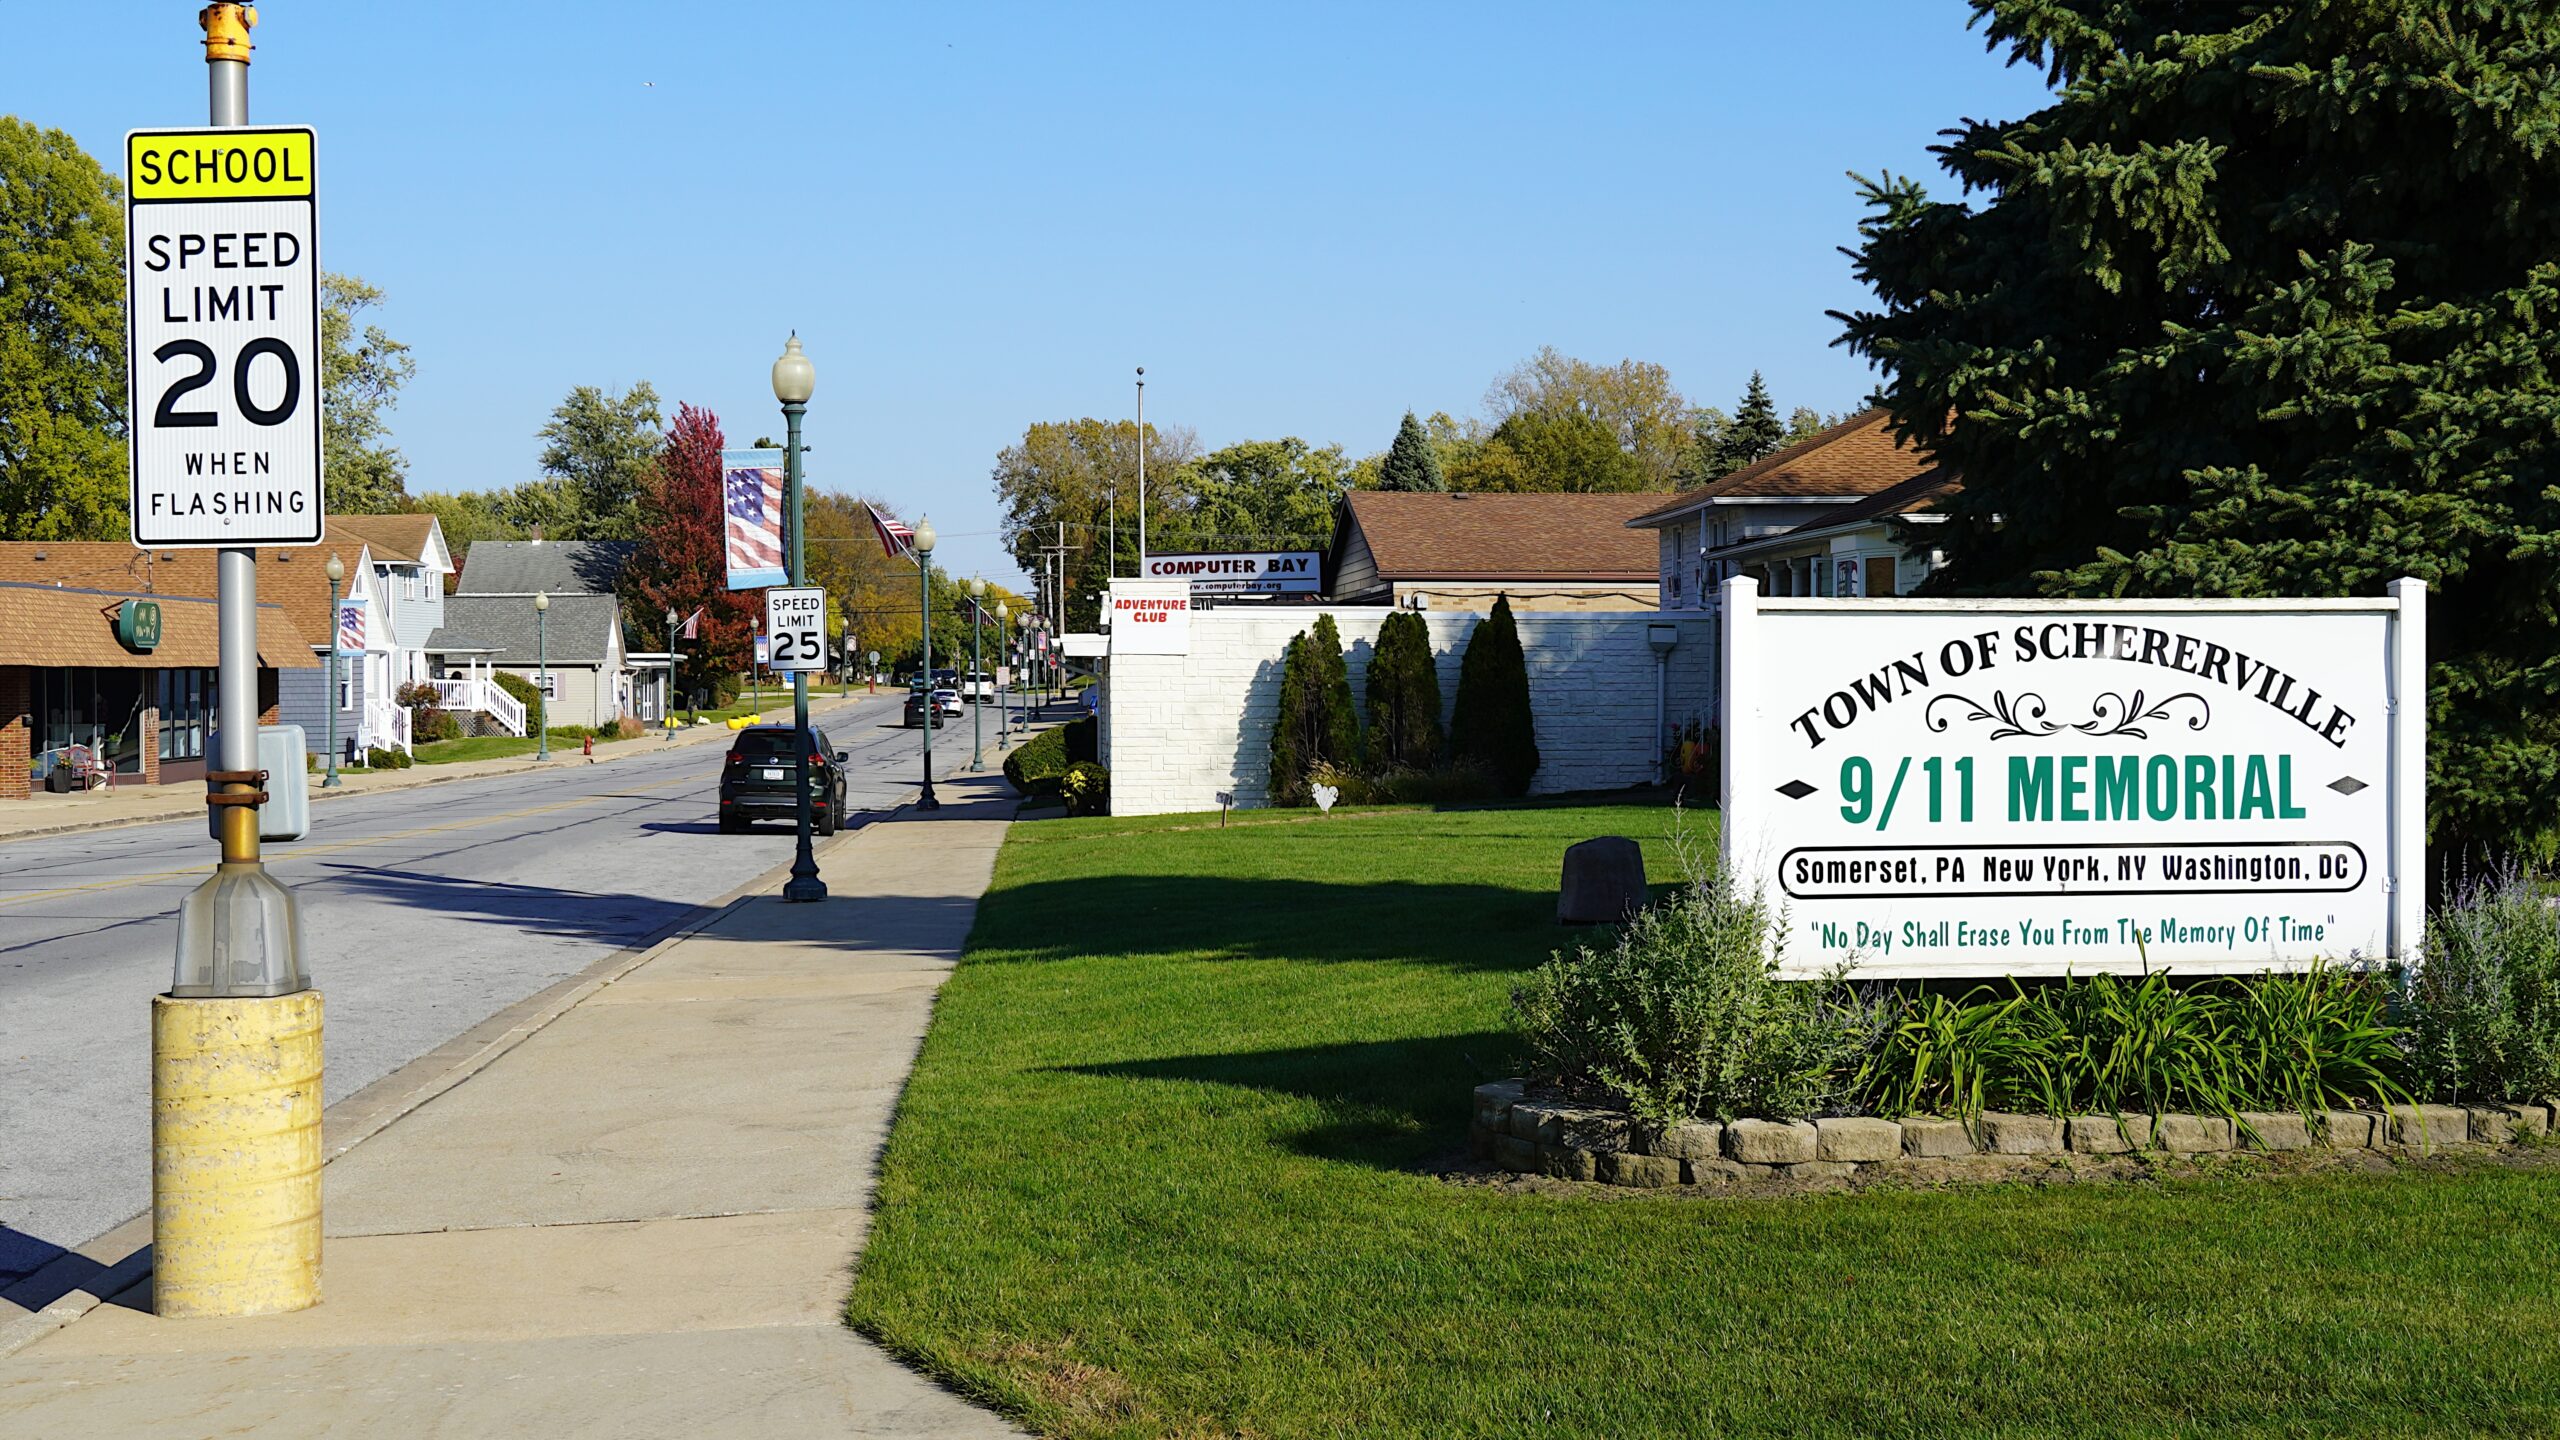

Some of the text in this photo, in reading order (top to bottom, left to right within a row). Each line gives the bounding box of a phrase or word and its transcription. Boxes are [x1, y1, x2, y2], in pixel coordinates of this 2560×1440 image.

[141, 148, 303, 184] SCHOOL
[145, 232, 299, 271] SPEED
[164, 285, 283, 322] LIMIT
[153, 337, 300, 428] 20
[186, 452, 268, 475] WHEN
[152, 491, 303, 515] FLASHING
[1151, 559, 1309, 575] COMPUTER BAY
[773, 598, 819, 610] SPEED
[1115, 600, 1186, 610] ADVENTURE
[1134, 612, 1167, 622] CLUB
[778, 615, 814, 627] LIMIT
[774, 632, 820, 661] 25
[1790, 623, 2355, 749] TOWN OF SCHERERVILLE
[1840, 755, 2306, 831] 9/11 MEMORIAL
[1797, 854, 2347, 884] Somerset, PA New York, NY Washington, DC
[1857, 921, 1893, 955] Day
[1902, 921, 1948, 947] Shall
[1958, 921, 2009, 946] Erase
[2020, 919, 2053, 945] You
[2063, 919, 2108, 944] From
[2117, 918, 2152, 944] The
[2161, 918, 2235, 950] Memory
[2245, 917, 2269, 942] Of
